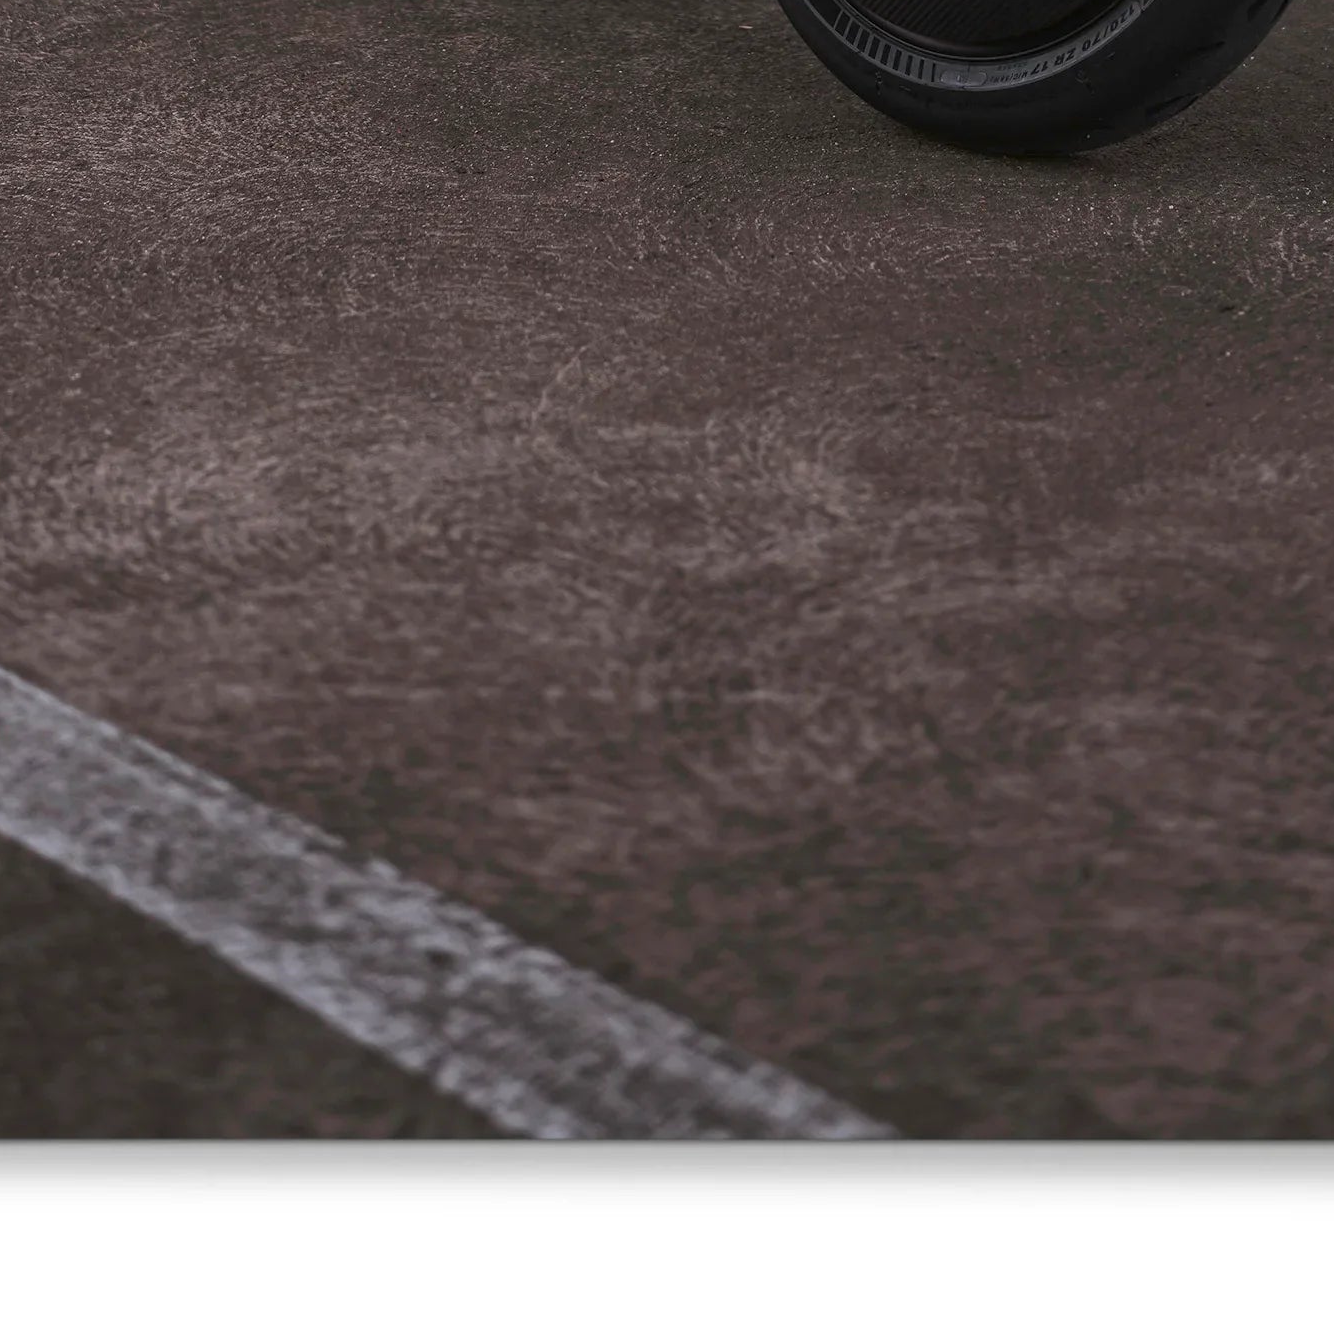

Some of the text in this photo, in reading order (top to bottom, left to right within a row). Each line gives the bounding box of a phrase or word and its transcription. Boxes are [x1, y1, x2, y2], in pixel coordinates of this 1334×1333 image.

[1082, 5, 1135, 52] 120/70
[1053, 48, 1076, 68] ZR
[1030, 61, 1049, 76] 17
